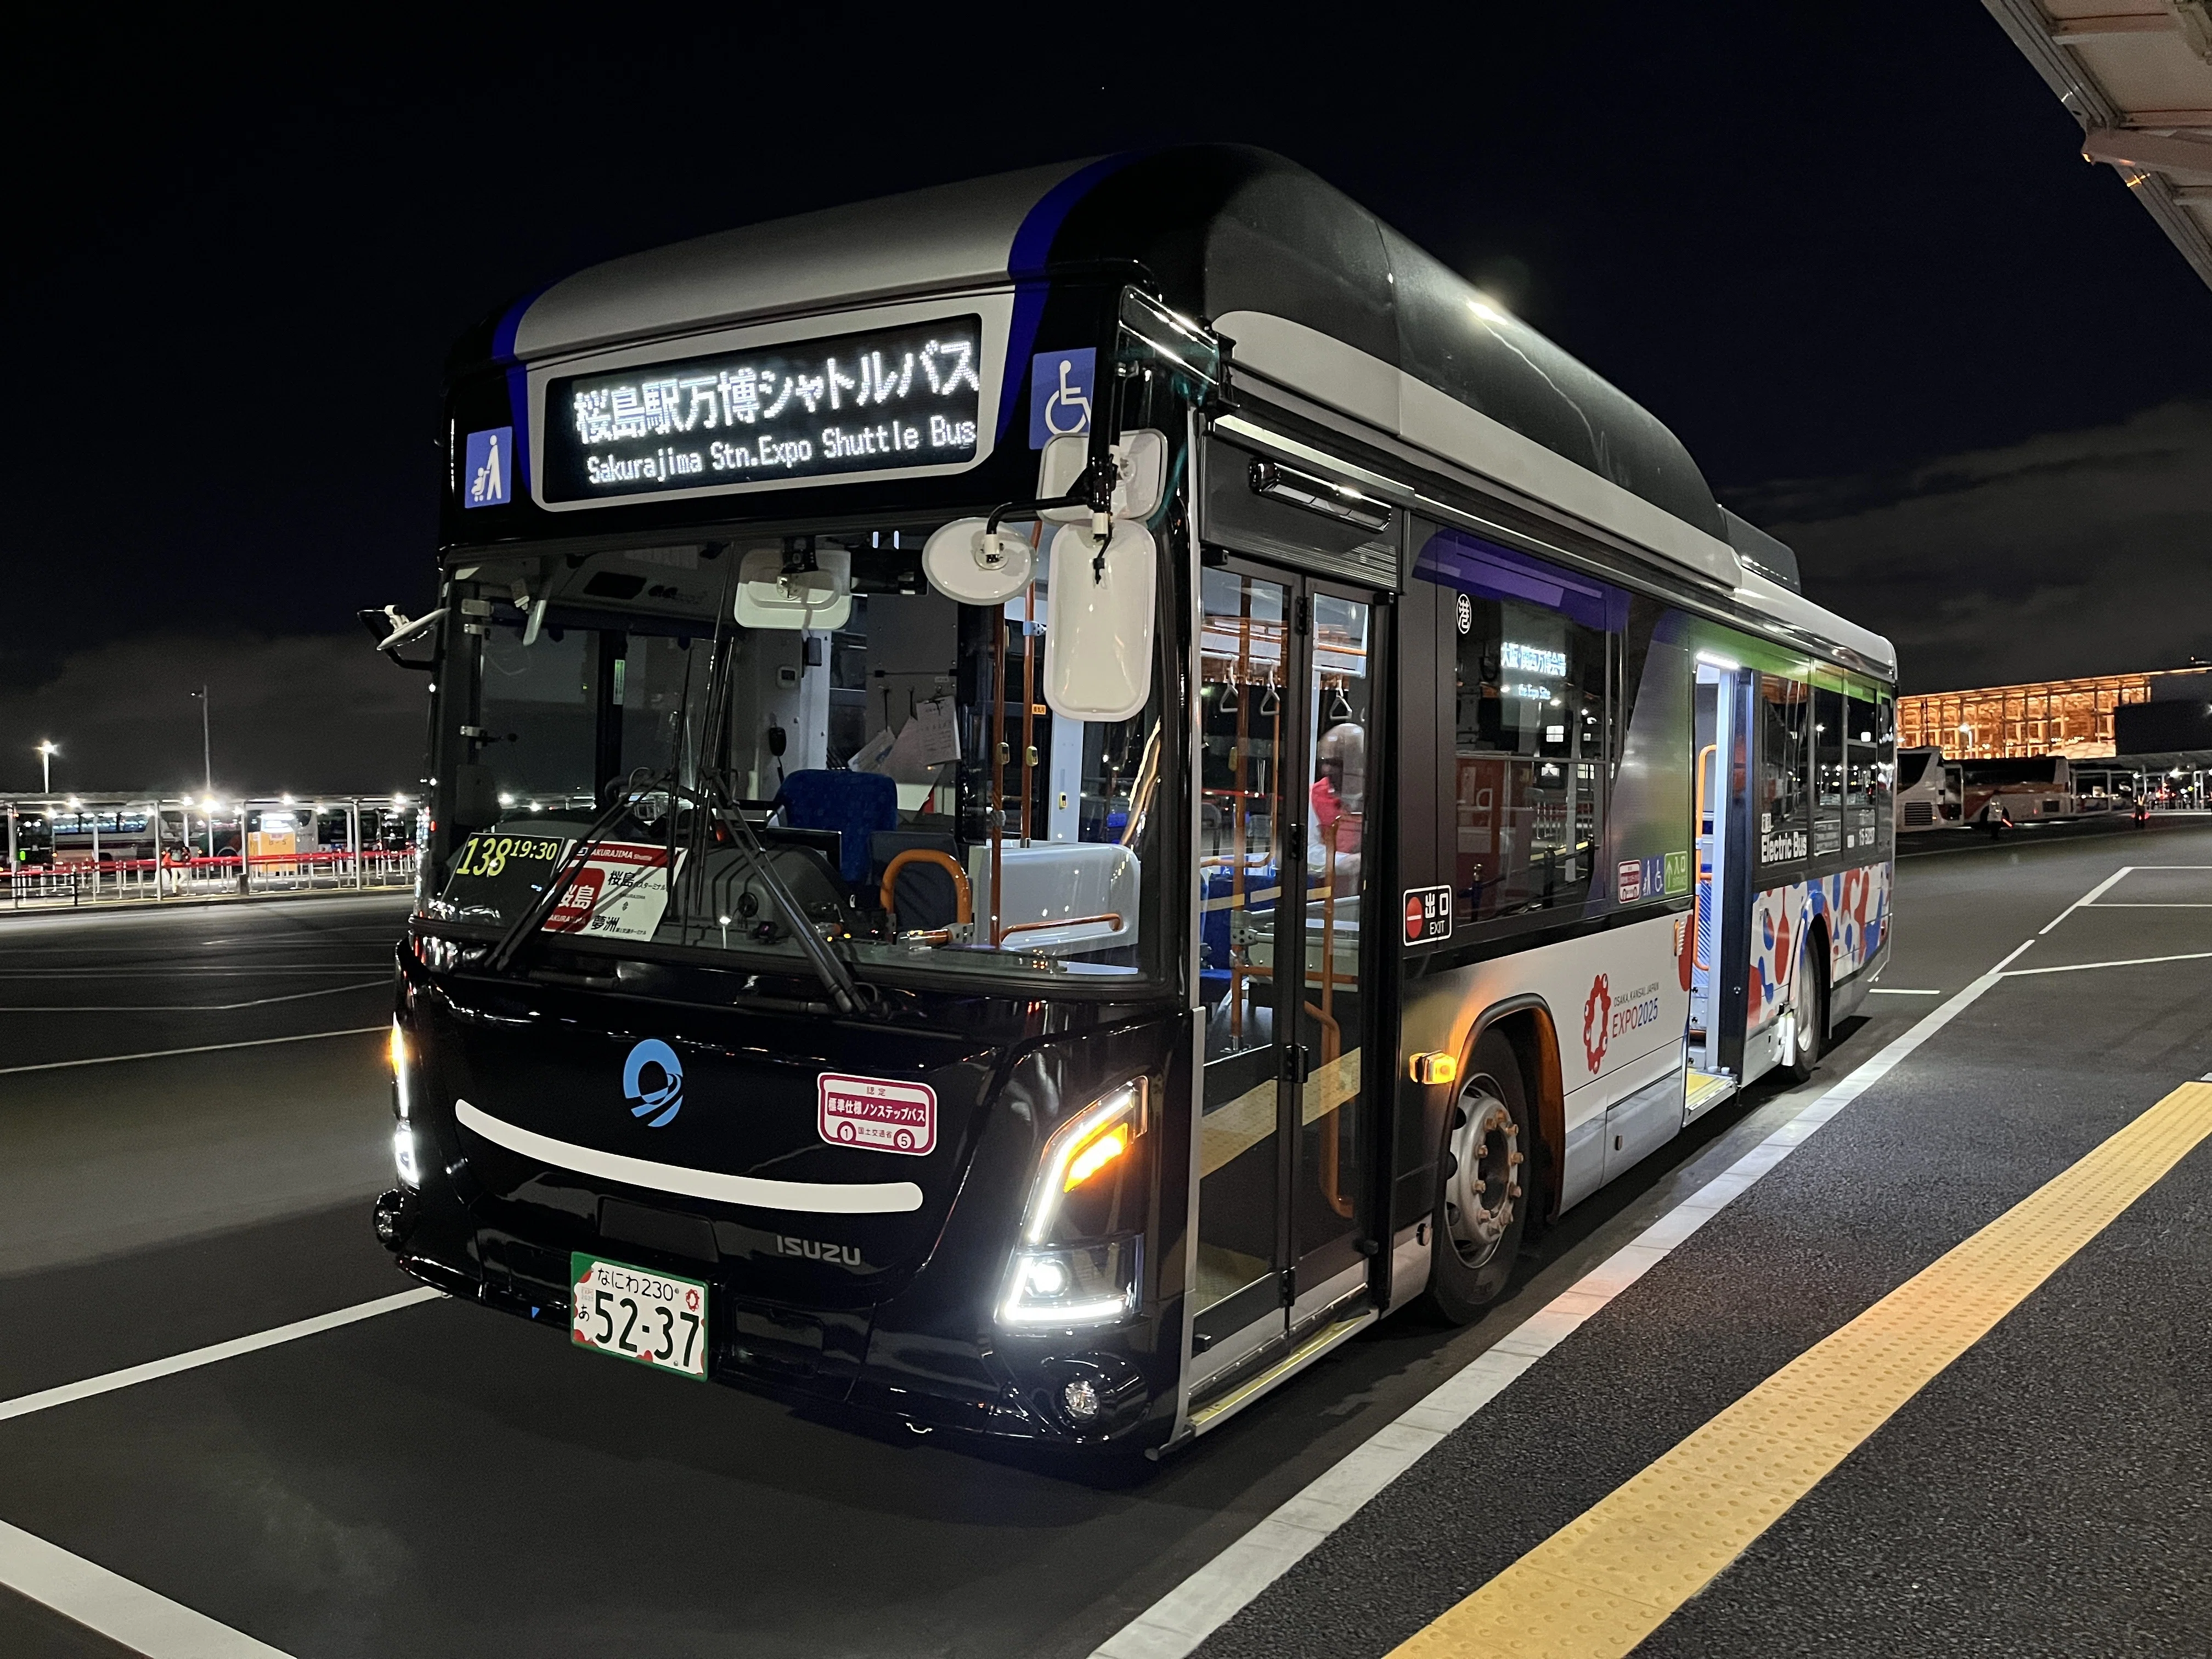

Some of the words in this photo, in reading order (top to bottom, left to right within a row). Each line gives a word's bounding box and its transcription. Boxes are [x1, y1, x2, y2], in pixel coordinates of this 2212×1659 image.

[574, 340, 980, 444] 桜島駅万博シャトルバス
[587, 454, 703, 484] Sakurajima
[822, 420, 919, 458] Shuttle
[930, 414, 977, 447] Bus
[456, 838, 512, 876] 138
[510, 840, 557, 860] 19:30
[589, 849, 633, 859] AKURAJIMA
[1761, 832, 1792, 863] Electric
[1793, 831, 1807, 857] Bus
[1673, 856, 1686, 875] 入口
[1425, 893, 1449, 918] 出口
[548, 914, 586, 925] AKURAJIMA
[1430, 920, 1445, 935] EXIT
[1612, 997, 1658, 1038] EXPO2025
[844, 1128, 848, 1138] 1
[901, 1136, 908, 1147] 5
[777, 1235, 861, 1266] ISUZU
[579, 1304, 590, 1322] あ
[595, 1289, 699, 1367] 52-37
